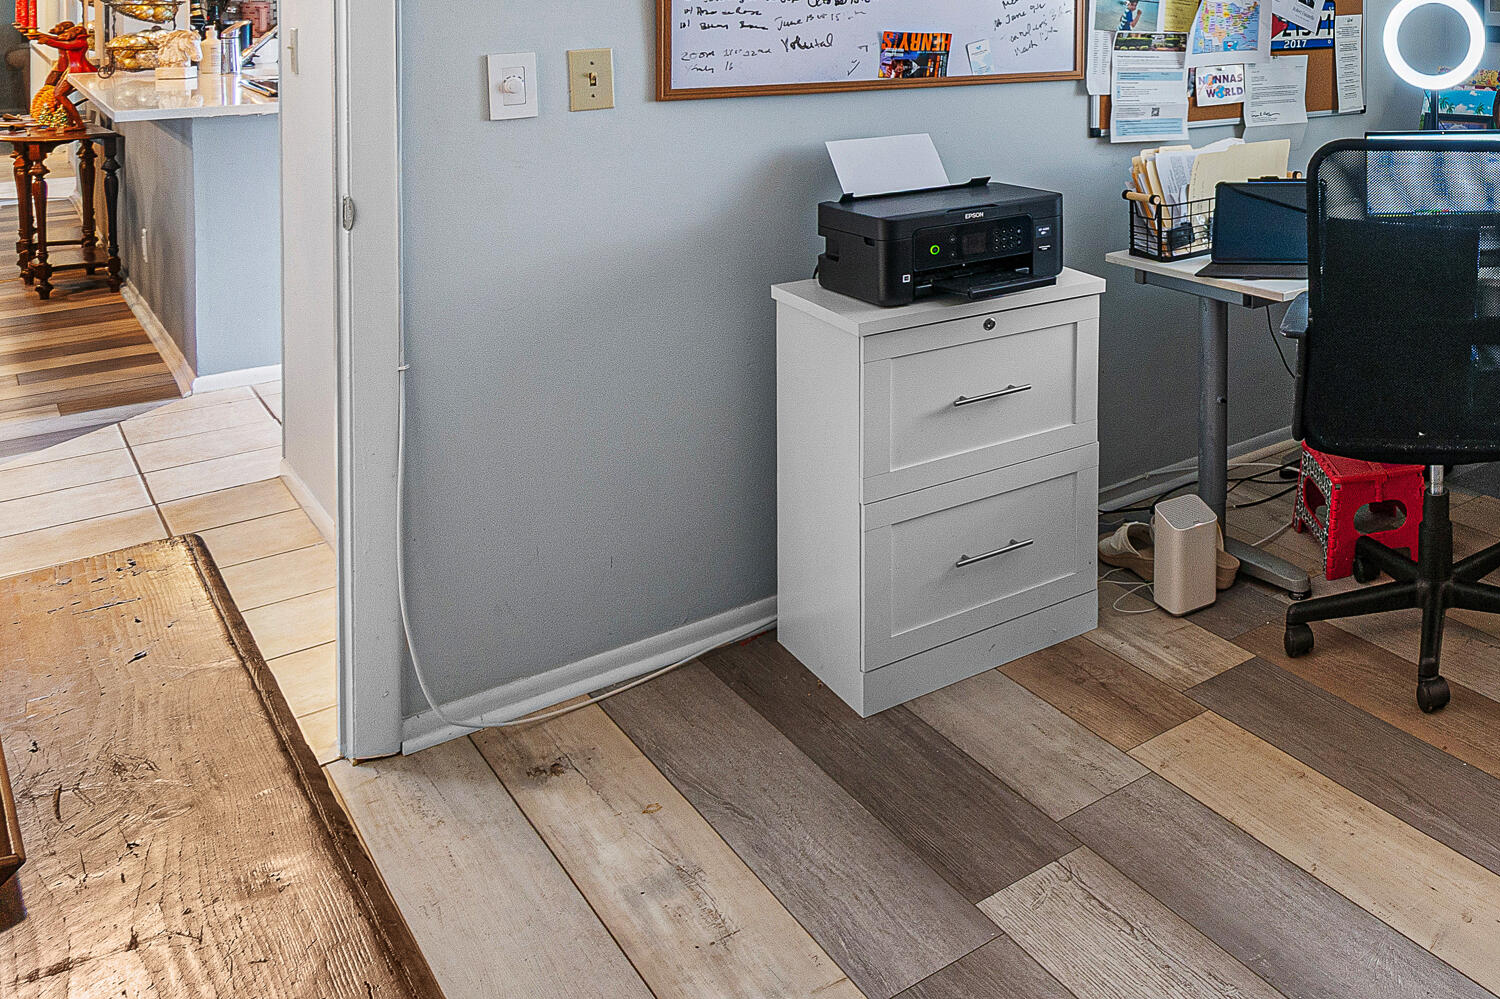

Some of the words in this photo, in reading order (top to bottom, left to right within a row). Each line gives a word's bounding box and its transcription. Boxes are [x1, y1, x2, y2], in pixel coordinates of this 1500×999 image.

[880, 31, 952, 52] HENRY'S
[1283, 39, 1308, 49] 2017
[1205, 85, 1244, 99] WORLD
[964, 211, 984, 220] EPSON
